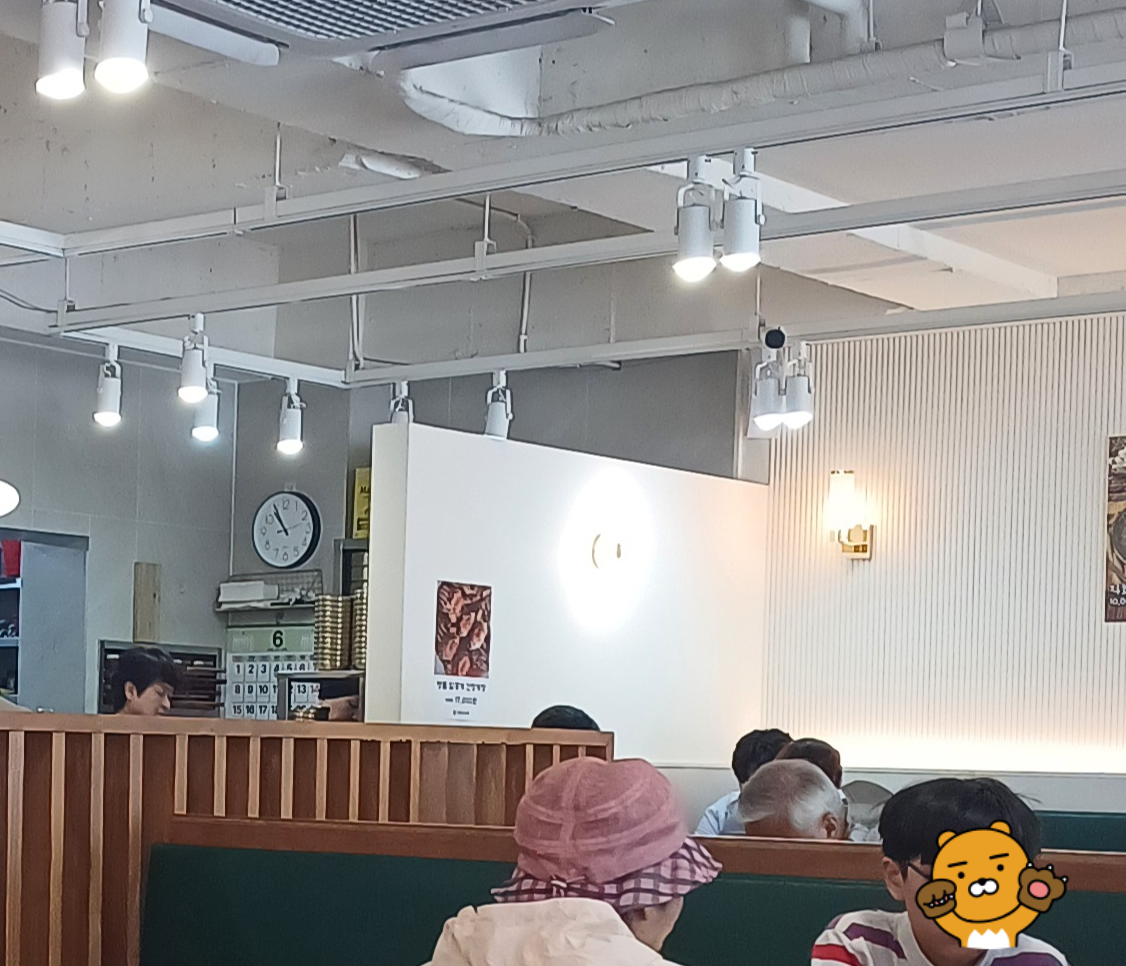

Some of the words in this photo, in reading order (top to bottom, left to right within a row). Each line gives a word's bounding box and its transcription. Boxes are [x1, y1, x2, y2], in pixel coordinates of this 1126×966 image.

[272, 630, 283, 648] 6
[236, 664, 241, 674] 1
[248, 664, 254, 674] 2
[261, 664, 266, 674] 3
[235, 684, 241, 694] 8
[247, 684, 254, 694] 9
[259, 684, 268, 694] 10
[297, 684, 306, 694] 13
[233, 705, 242, 715] 15
[259, 704, 267, 715] 17
